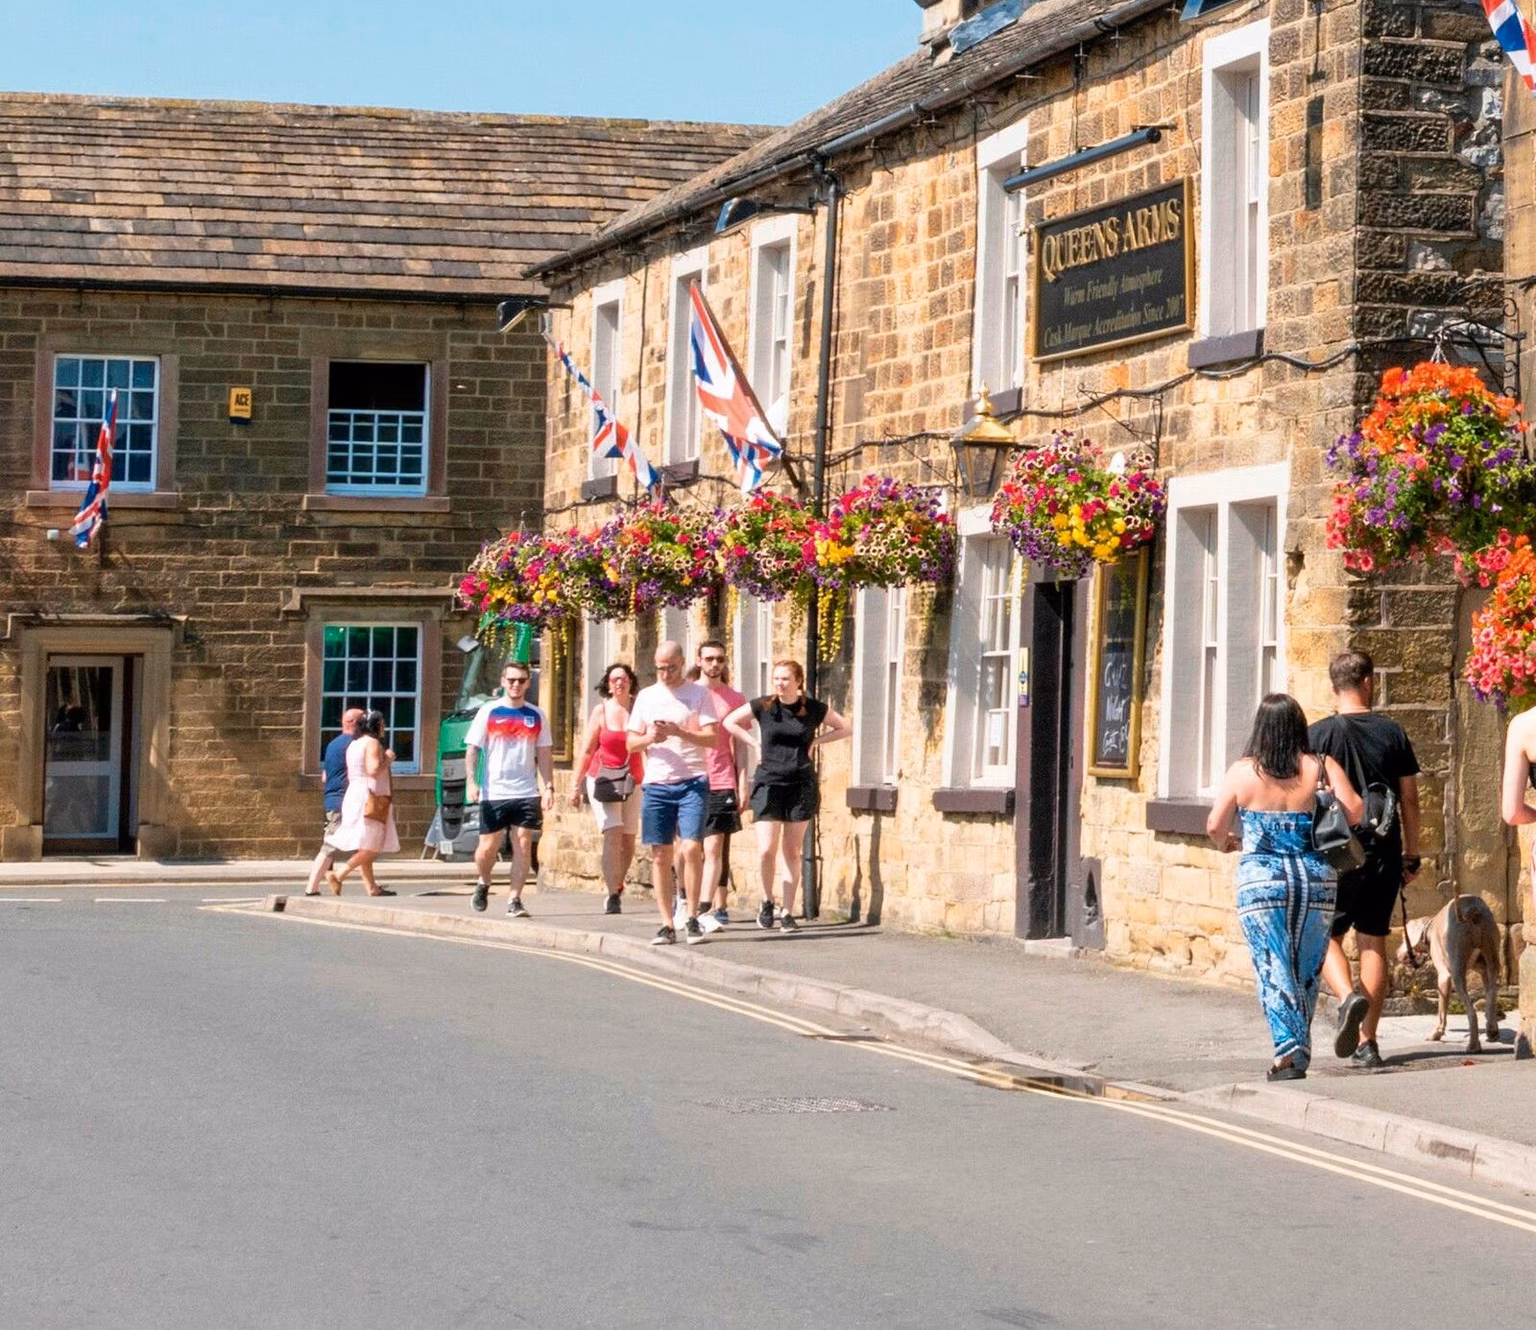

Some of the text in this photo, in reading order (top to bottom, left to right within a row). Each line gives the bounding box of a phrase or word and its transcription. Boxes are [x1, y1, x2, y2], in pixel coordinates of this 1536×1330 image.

[1042, 198, 1181, 284] QUEENS ARMS
[235, 393, 249, 406] ACE
